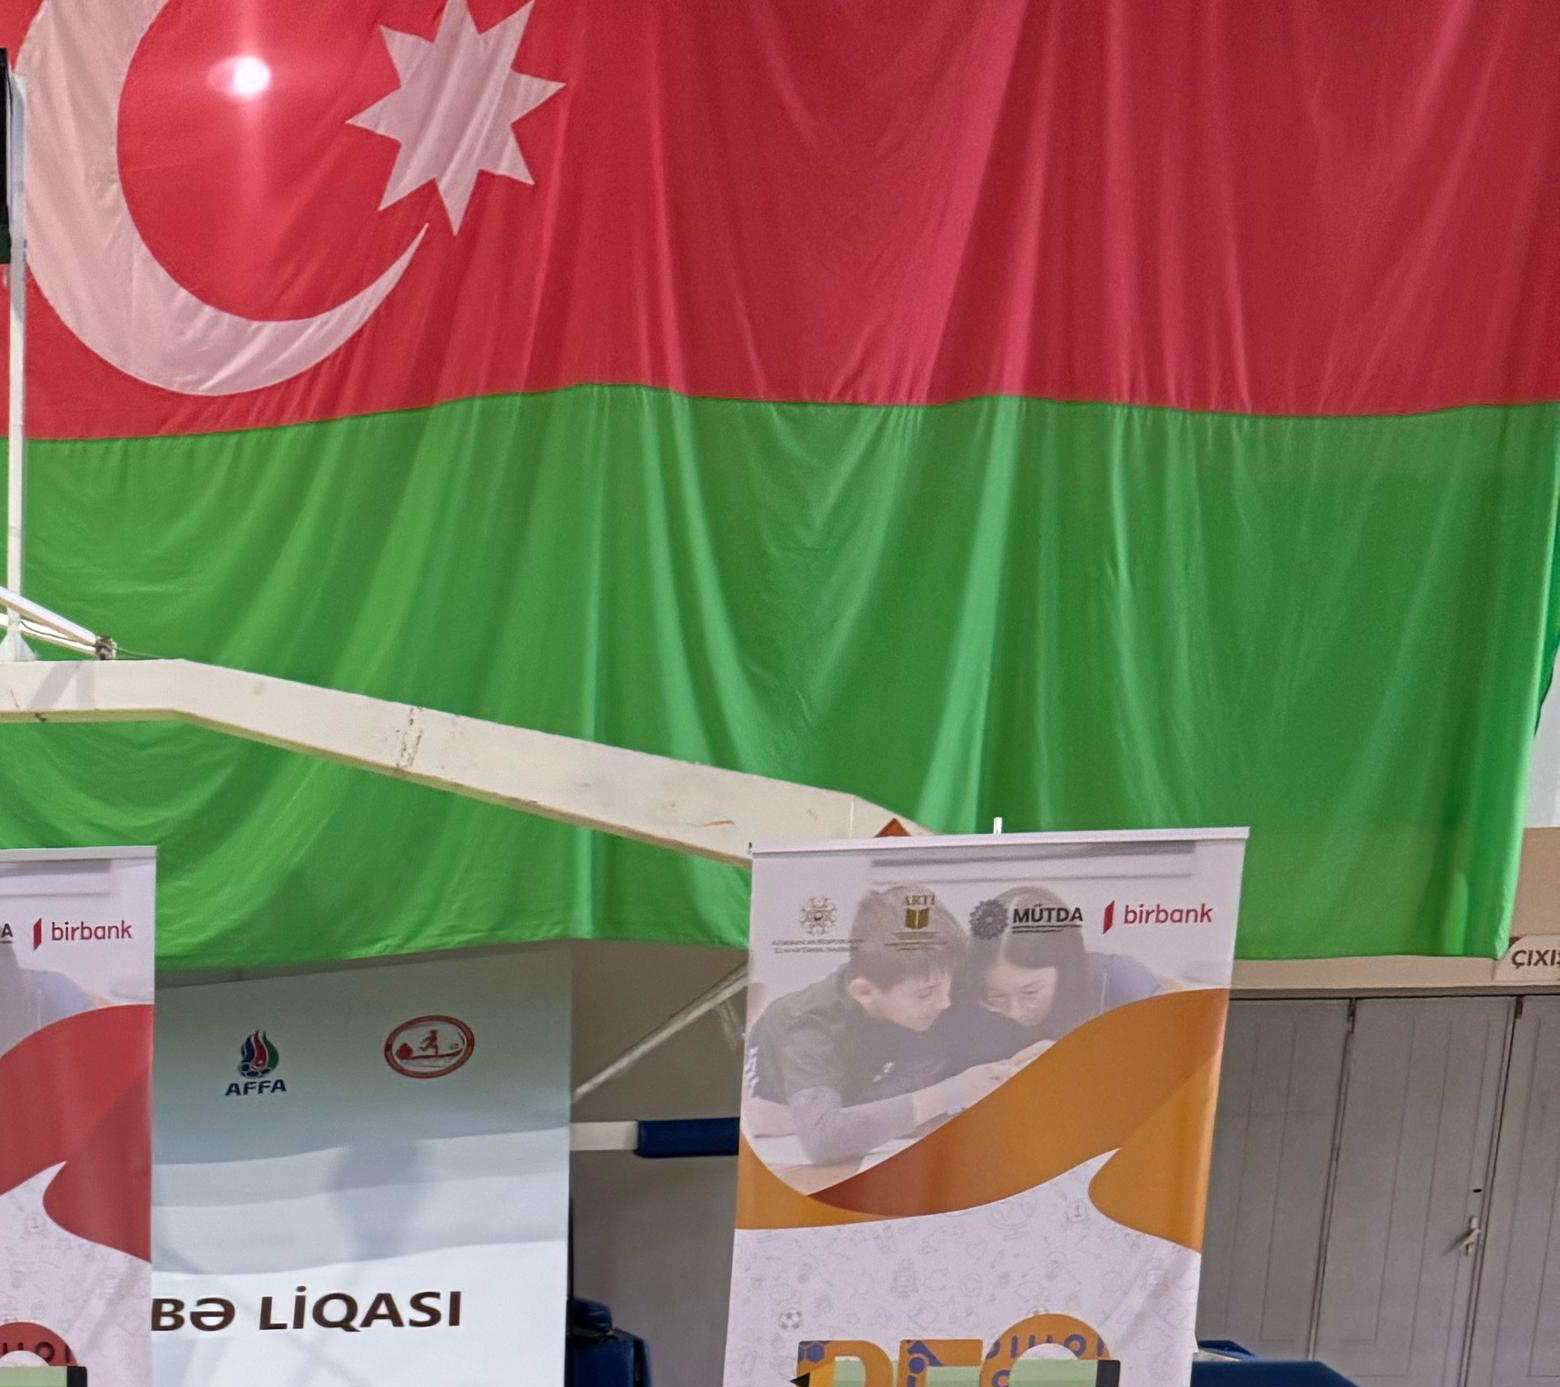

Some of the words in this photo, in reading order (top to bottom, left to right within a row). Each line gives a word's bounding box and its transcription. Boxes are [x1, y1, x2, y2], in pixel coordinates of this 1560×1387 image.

[1123, 903, 1213, 924] birbank
[51, 920, 133, 942] birbank
[1511, 949, 1560, 970] ÇIXI
[225, 1079, 287, 1096] AFFA
[258, 1286, 462, 1333] LİQASI
